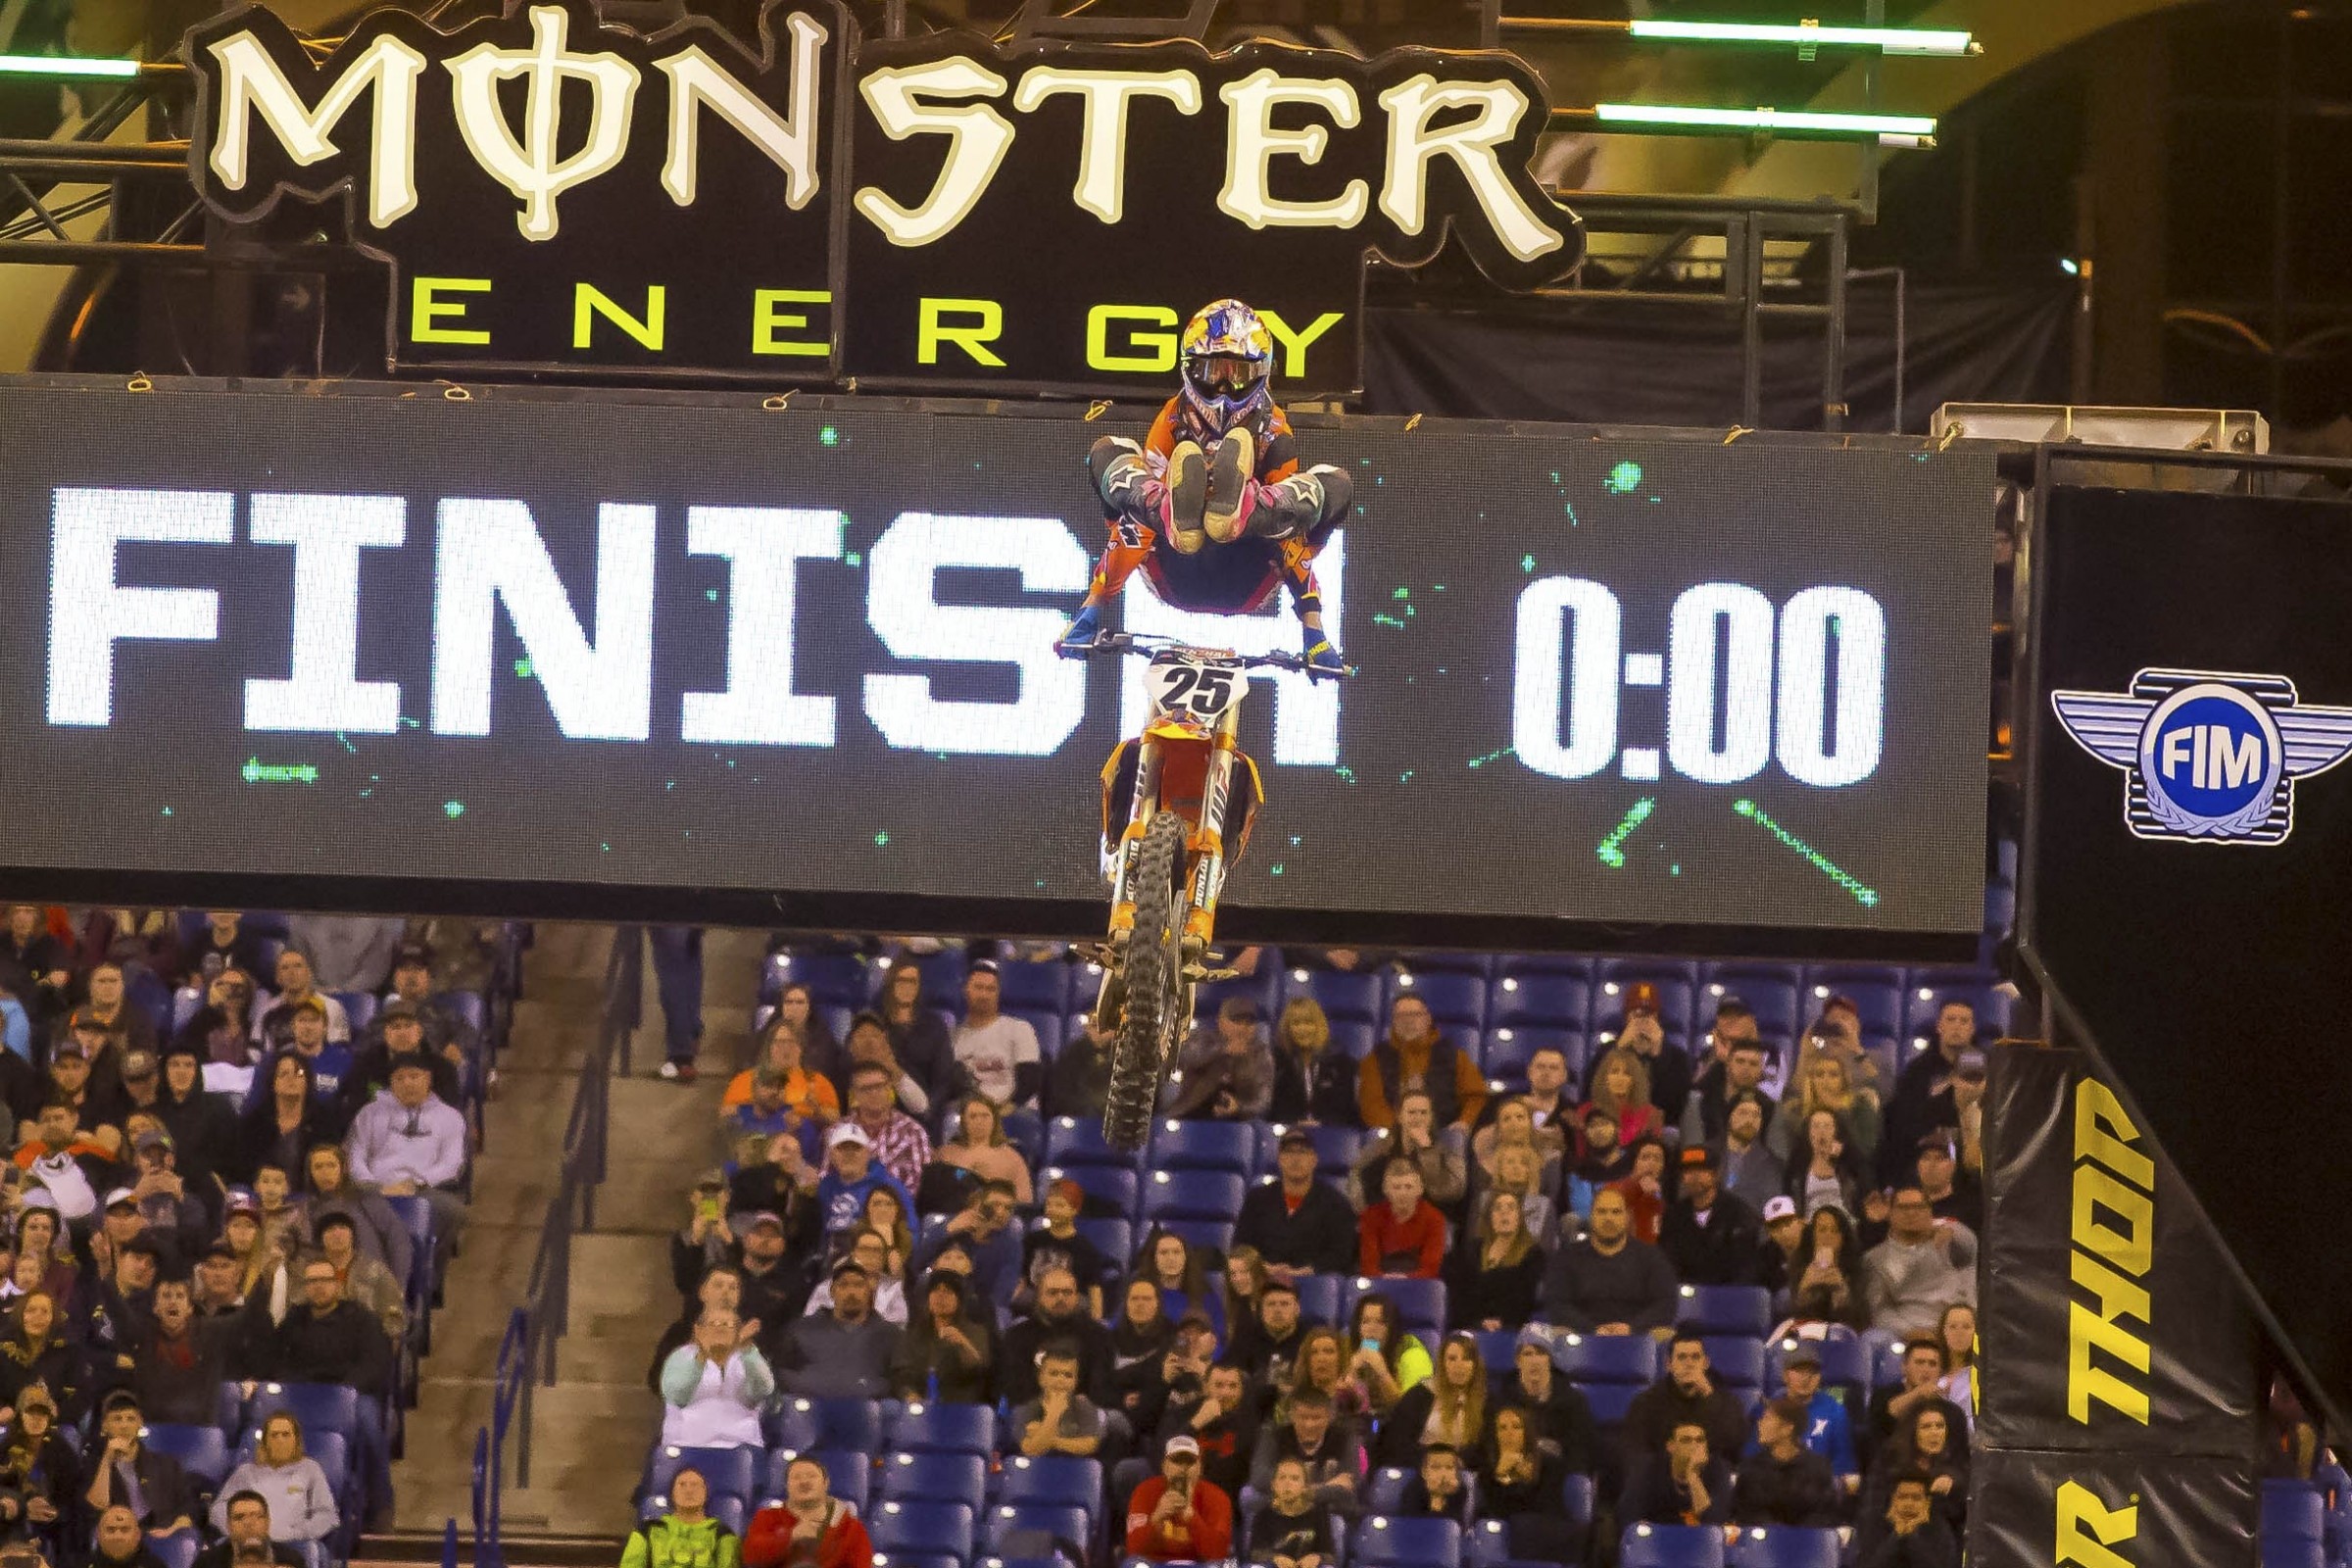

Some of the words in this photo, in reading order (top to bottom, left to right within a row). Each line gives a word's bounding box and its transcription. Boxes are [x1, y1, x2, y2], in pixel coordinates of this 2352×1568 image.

[208, 5, 1565, 263] MONSTER
[410, 276, 1345, 377] ENERGY
[46, 486, 1347, 766] FINISH
[1160, 668, 1235, 713] 25
[1513, 575, 1885, 787] 0:00
[2162, 724, 2262, 790] FIM
[1195, 855, 1209, 907] DUNLO
[2068, 1077, 2155, 1427] THOR
